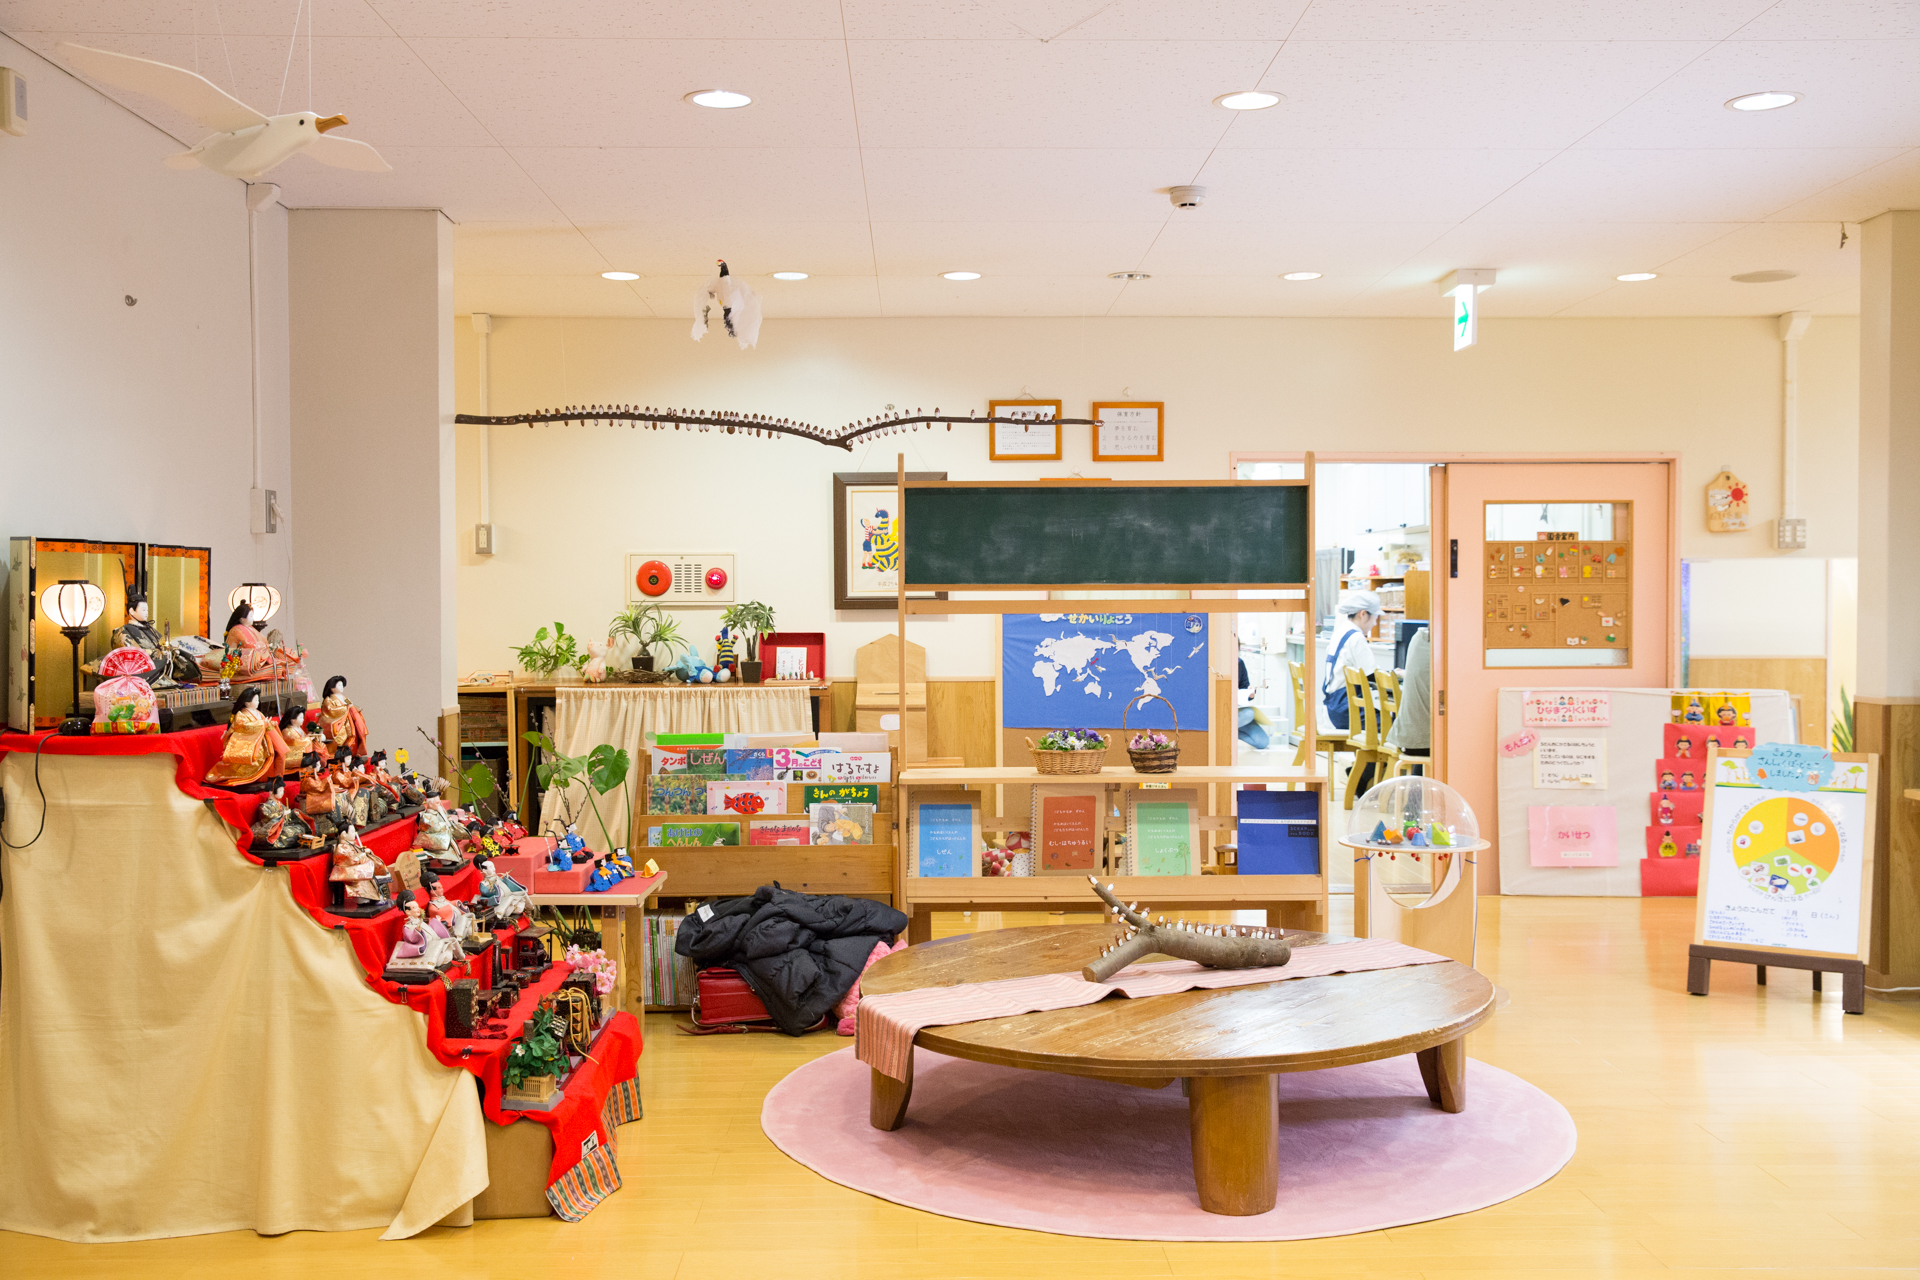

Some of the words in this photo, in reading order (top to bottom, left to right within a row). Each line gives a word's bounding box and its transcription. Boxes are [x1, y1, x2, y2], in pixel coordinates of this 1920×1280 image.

[1067, 613, 1133, 625] せかいりょこう
[1537, 706, 1598, 714] ひなまつりくいず
[1772, 747, 1801, 757] きょうの
[690, 752, 725, 765] しぜん
[832, 763, 880, 774] はるですよ
[656, 787, 691, 797] つんつん
[813, 787, 836, 799] きんの
[839, 786, 869, 798] がちょう
[1557, 831, 1591, 839] かいせつ
[1048, 839, 1092, 847] むし・はちゅうるい
[1725, 904, 1776, 915] きょうのこんだて
